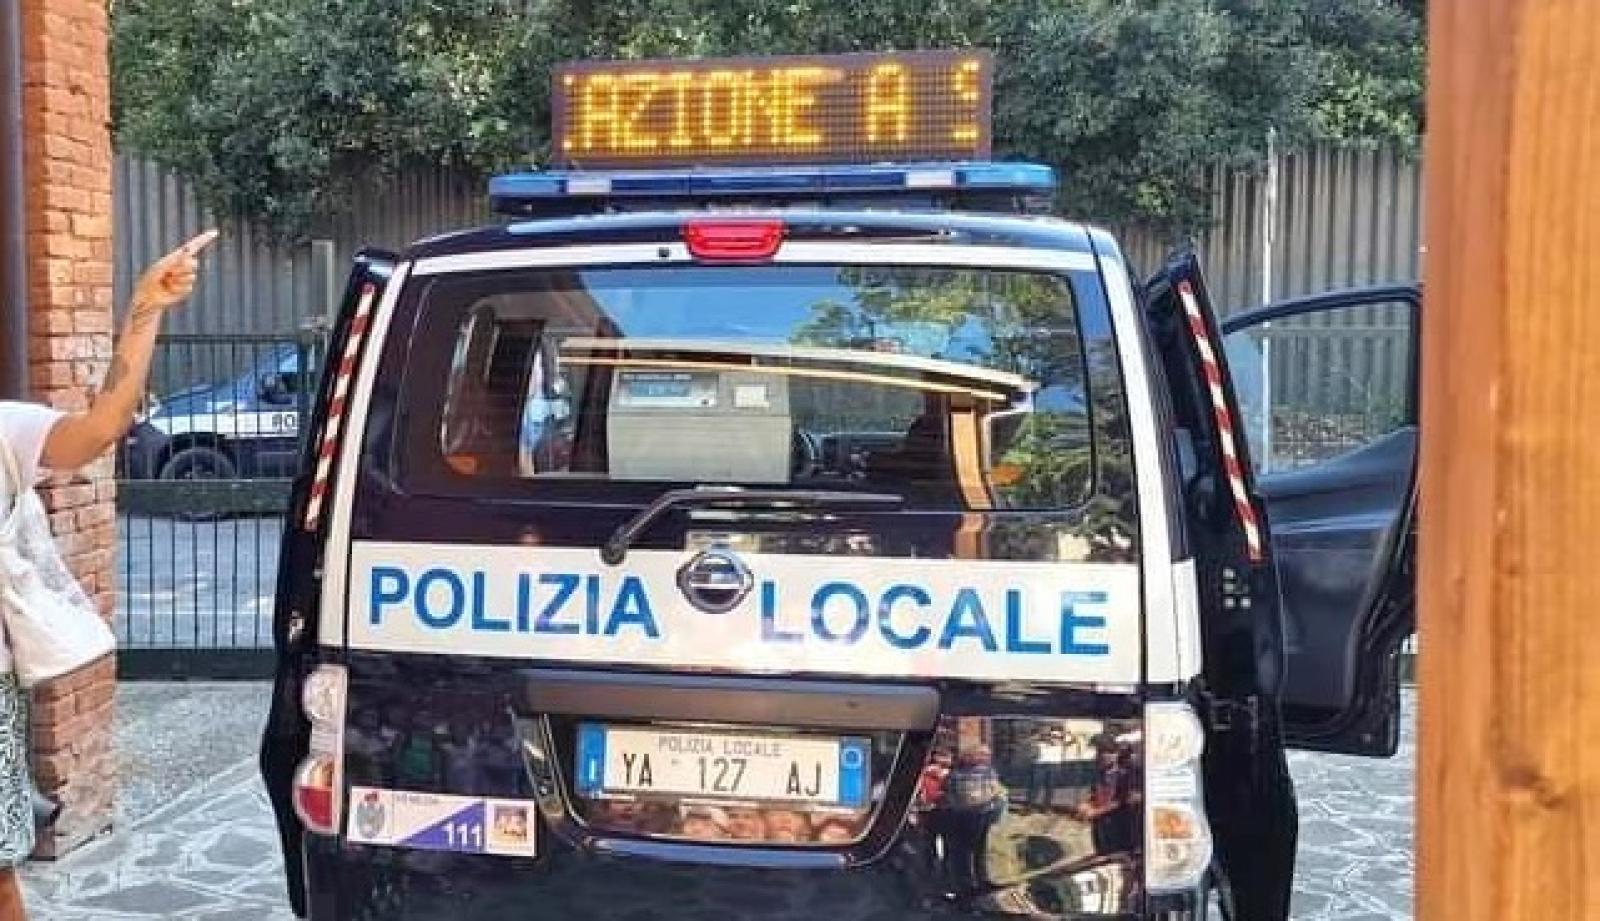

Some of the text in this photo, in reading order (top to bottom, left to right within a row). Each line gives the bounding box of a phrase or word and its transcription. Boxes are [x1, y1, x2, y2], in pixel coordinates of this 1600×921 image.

[563, 68, 823, 150] AZIONE
[868, 63, 906, 142] A
[368, 565, 1110, 655] POLIZIA LOCALE
[658, 735, 783, 757] POLIZIA LOCALE
[622, 753, 823, 797] YA 127 AJ
[445, 822, 481, 847] 111
